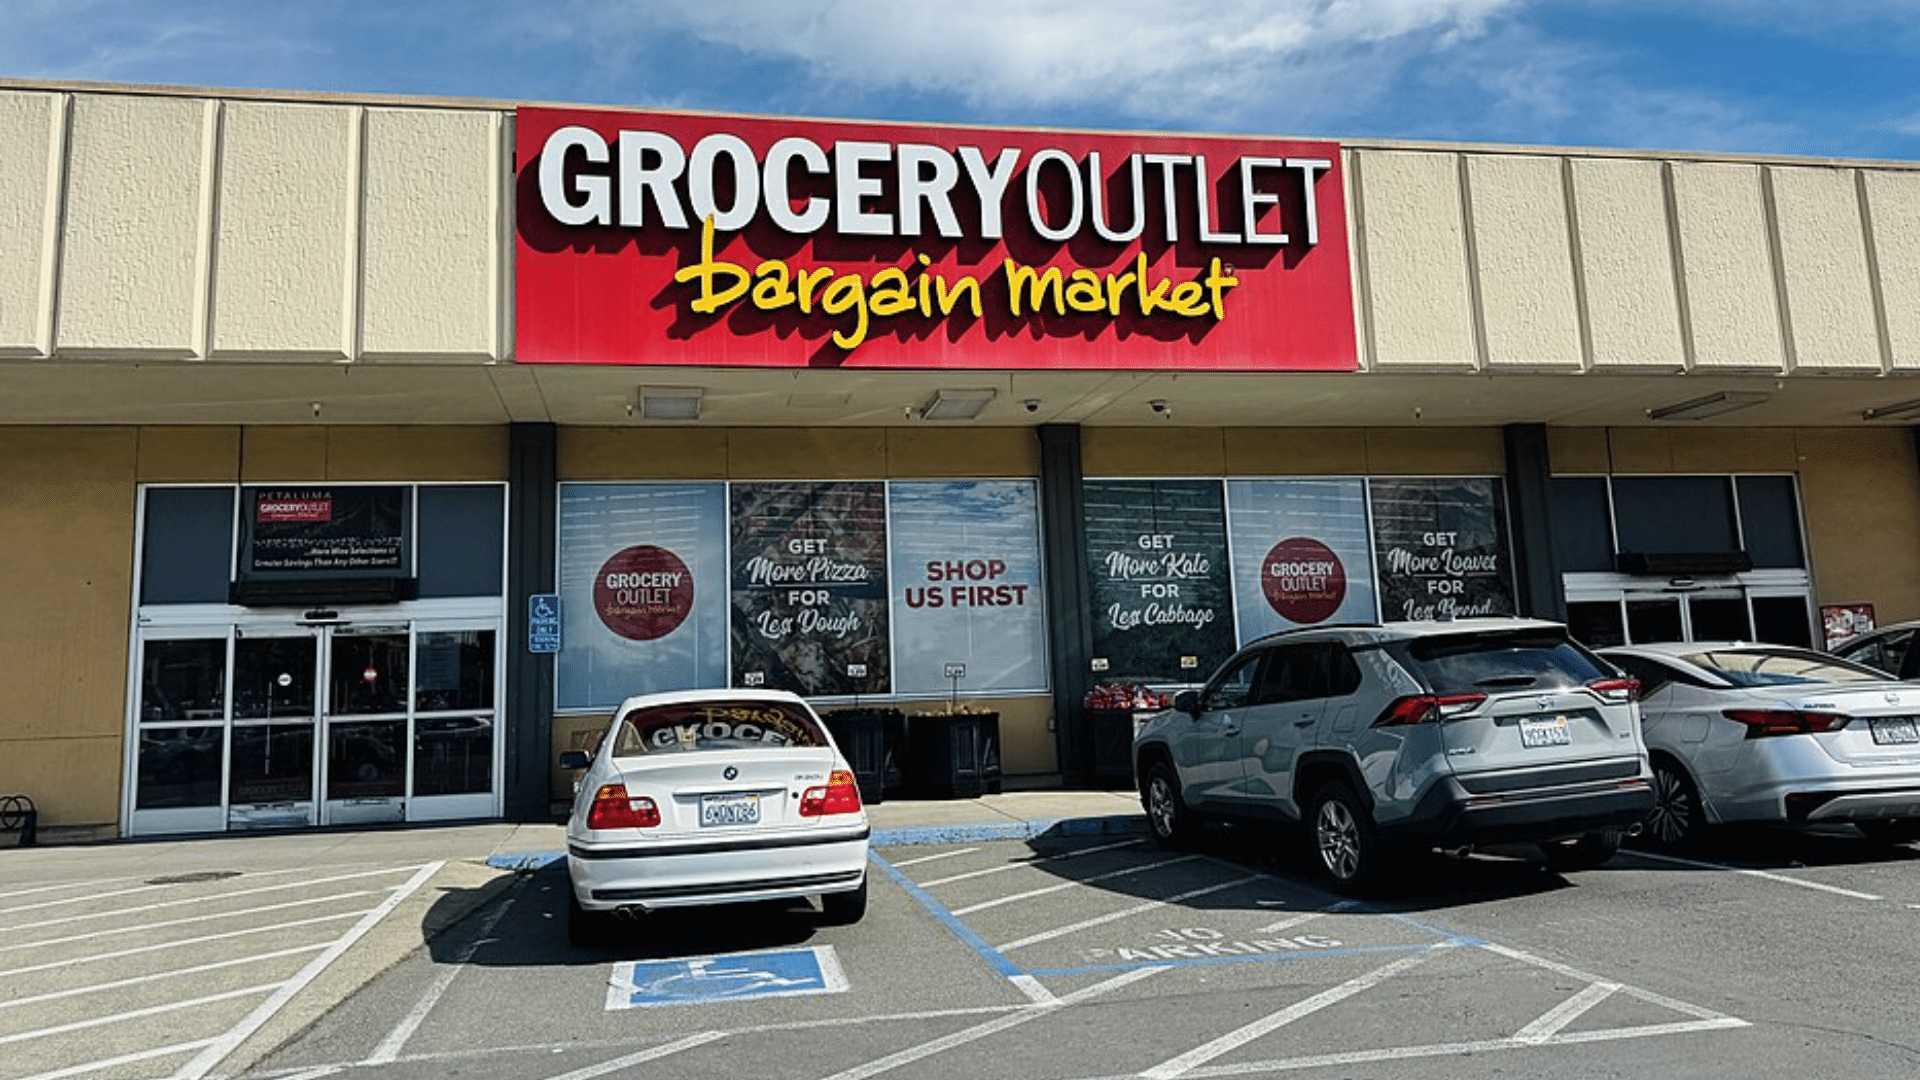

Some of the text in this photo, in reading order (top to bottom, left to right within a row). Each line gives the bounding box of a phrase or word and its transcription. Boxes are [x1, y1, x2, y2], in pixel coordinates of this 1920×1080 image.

[538, 126, 1332, 246] GROCERY OUTLET
[674, 214, 1239, 350] bargain market
[259, 491, 332, 500] PETALUMA
[788, 538, 828, 554] GET
[1138, 534, 1174, 549] GET
[1423, 532, 1458, 546] GET
[1105, 551, 1211, 580] More Kale
[1271, 561, 1335, 577] GROCERY
[1387, 547, 1497, 576] More Loaves
[747, 557, 869, 586] More Pizza
[926, 560, 1006, 581] SHOP
[606, 572, 682, 589] GROCERY
[1281, 575, 1327, 591] OUTLET
[1427, 580, 1464, 595] FOR
[616, 588, 671, 605] OUTLET
[788, 590, 830, 606] FOR
[905, 585, 1028, 608] US FIRST
[1141, 584, 1180, 598] FOR
[757, 610, 861, 639] Less Dough
[1108, 602, 1215, 631] Less Cabbage
